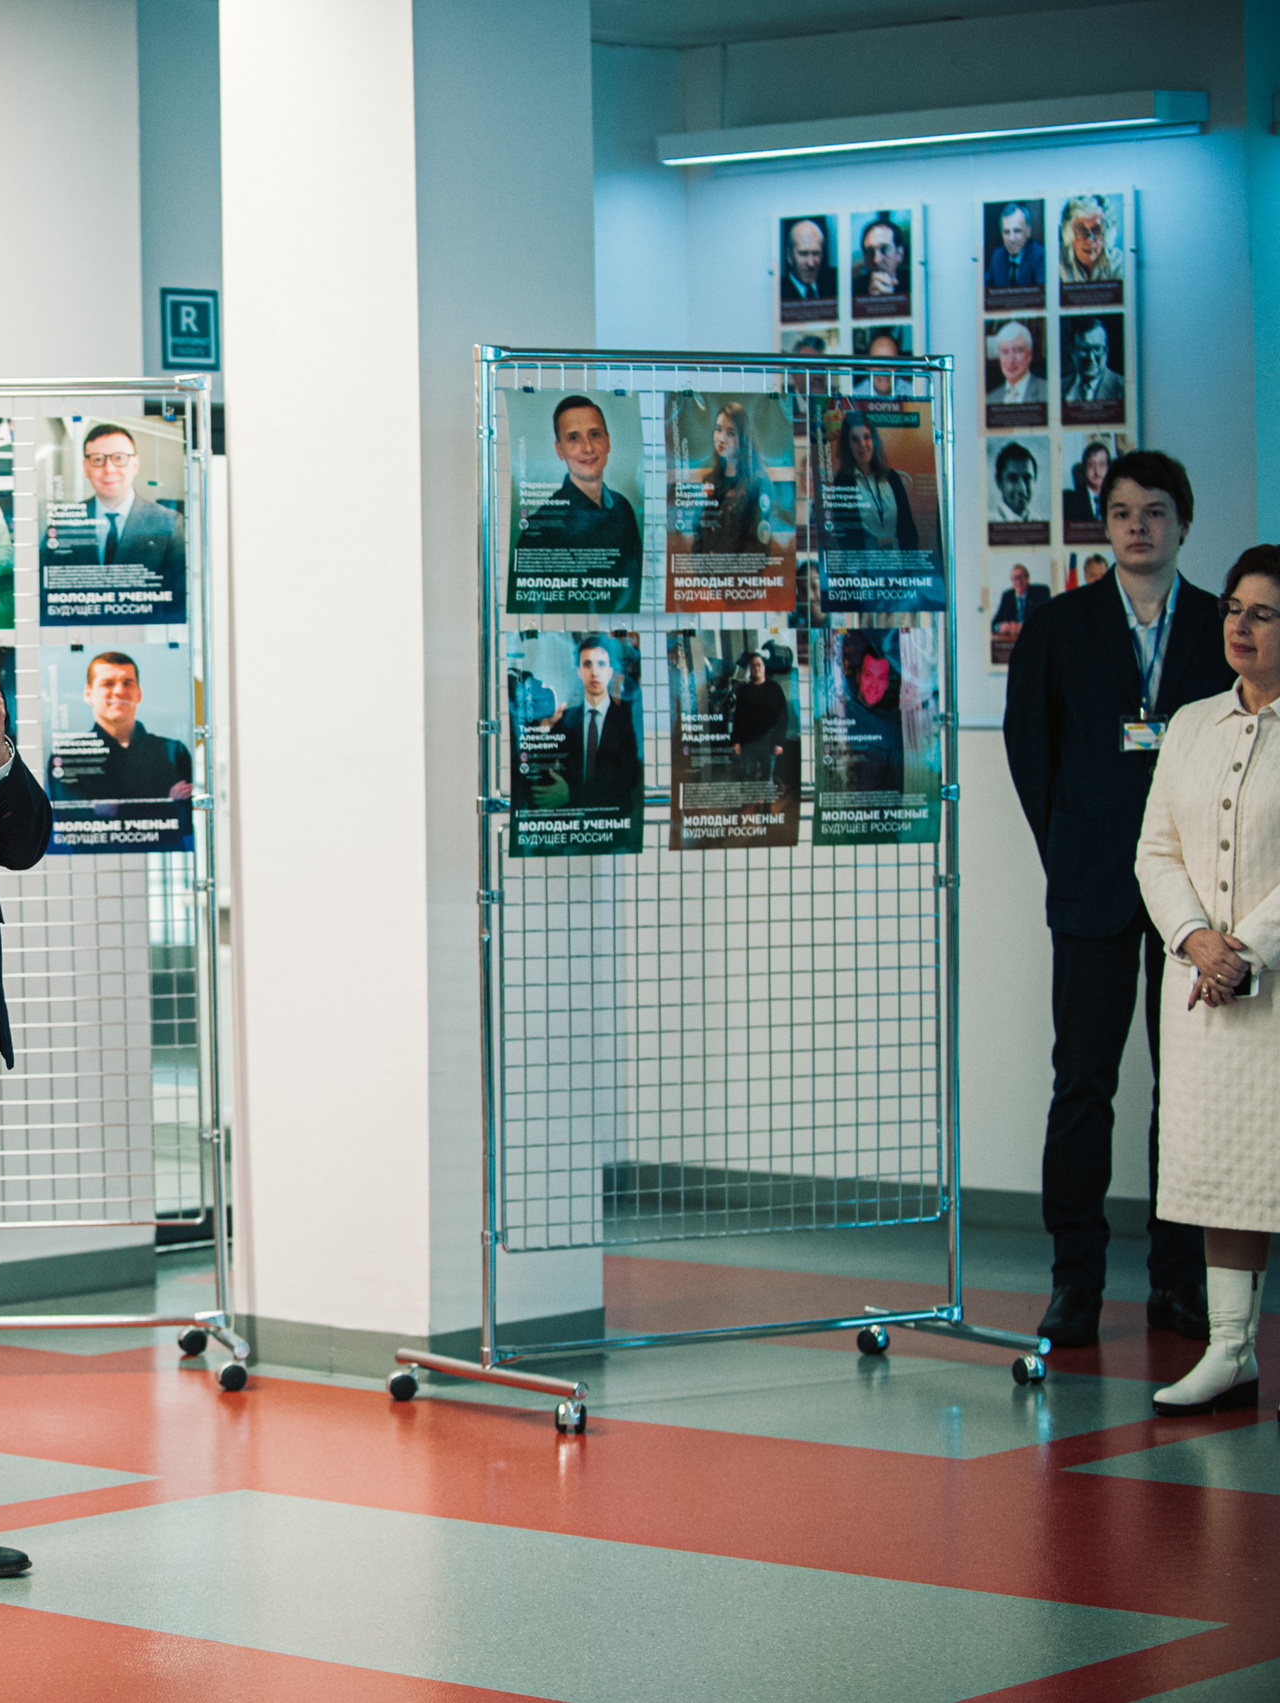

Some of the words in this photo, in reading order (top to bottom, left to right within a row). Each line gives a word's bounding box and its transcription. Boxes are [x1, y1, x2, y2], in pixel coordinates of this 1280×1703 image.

[181, 305, 200, 333] R
[868, 402, 899, 412] ФОРУМ
[520, 498, 571, 507] Алексеевич
[675, 499, 720, 509] Сергеевна
[516, 577, 579, 589] МОЛОДЫЕ
[581, 577, 629, 588] УЧЕНЫЕ
[674, 577, 735, 589] МОЛОДЫЕ
[737, 576, 784, 587] УЧЕНЫЕ
[827, 577, 886, 589] МОЛОДЫЕ
[888, 576, 933, 588] УЧЕНЫЕ
[47, 592, 115, 604] МОЛОДЫЕ
[118, 591, 172, 602] УЧЕНЫЕ
[515, 590, 566, 602] БУДУЩЕЕ
[568, 590, 611, 601] РОССИИ
[673, 589, 723, 602] БУДУЩЕЕ
[725, 588, 767, 600] РОССИИ
[828, 589, 875, 602] БУДУЩЕЕ
[876, 588, 918, 600] РОССИИ
[47, 605, 102, 616] БУДУЩЕЕ
[104, 604, 153, 615] РОССИИ
[681, 713, 723, 722] Беспалов
[519, 725, 550, 733] Тычков
[681, 723, 703, 732] Иван
[519, 733, 566, 742] Александр
[681, 733, 731, 742] Андреевич
[519, 742, 559, 751] Юрьевич
[683, 815, 738, 827] МОЛОДЫЕ
[741, 813, 785, 825] УЧЕНЫЕ
[822, 810, 880, 822] МОЛОДЫЕ
[883, 809, 929, 820] УЧЕНЫЕ
[53, 821, 122, 832] МОЛОДЫЕ
[124, 819, 179, 830] УЧЕНЫЕ
[518, 820, 580, 833] МОЛОДЫЕ
[583, 818, 631, 830] УЧЕНЫЕ
[821, 823, 869, 834] БУДУЩЕЕ
[870, 822, 912, 833] РОССИИ
[683, 827, 725, 838] БУДУЩЕЕ
[727, 826, 767, 837] РОССИИ
[53, 833, 108, 845] БУДУЩЕЕ
[110, 832, 159, 843] РОССИИ
[518, 833, 567, 846] БУДУЩЕЕ
[569, 832, 613, 843] РОССИИ
